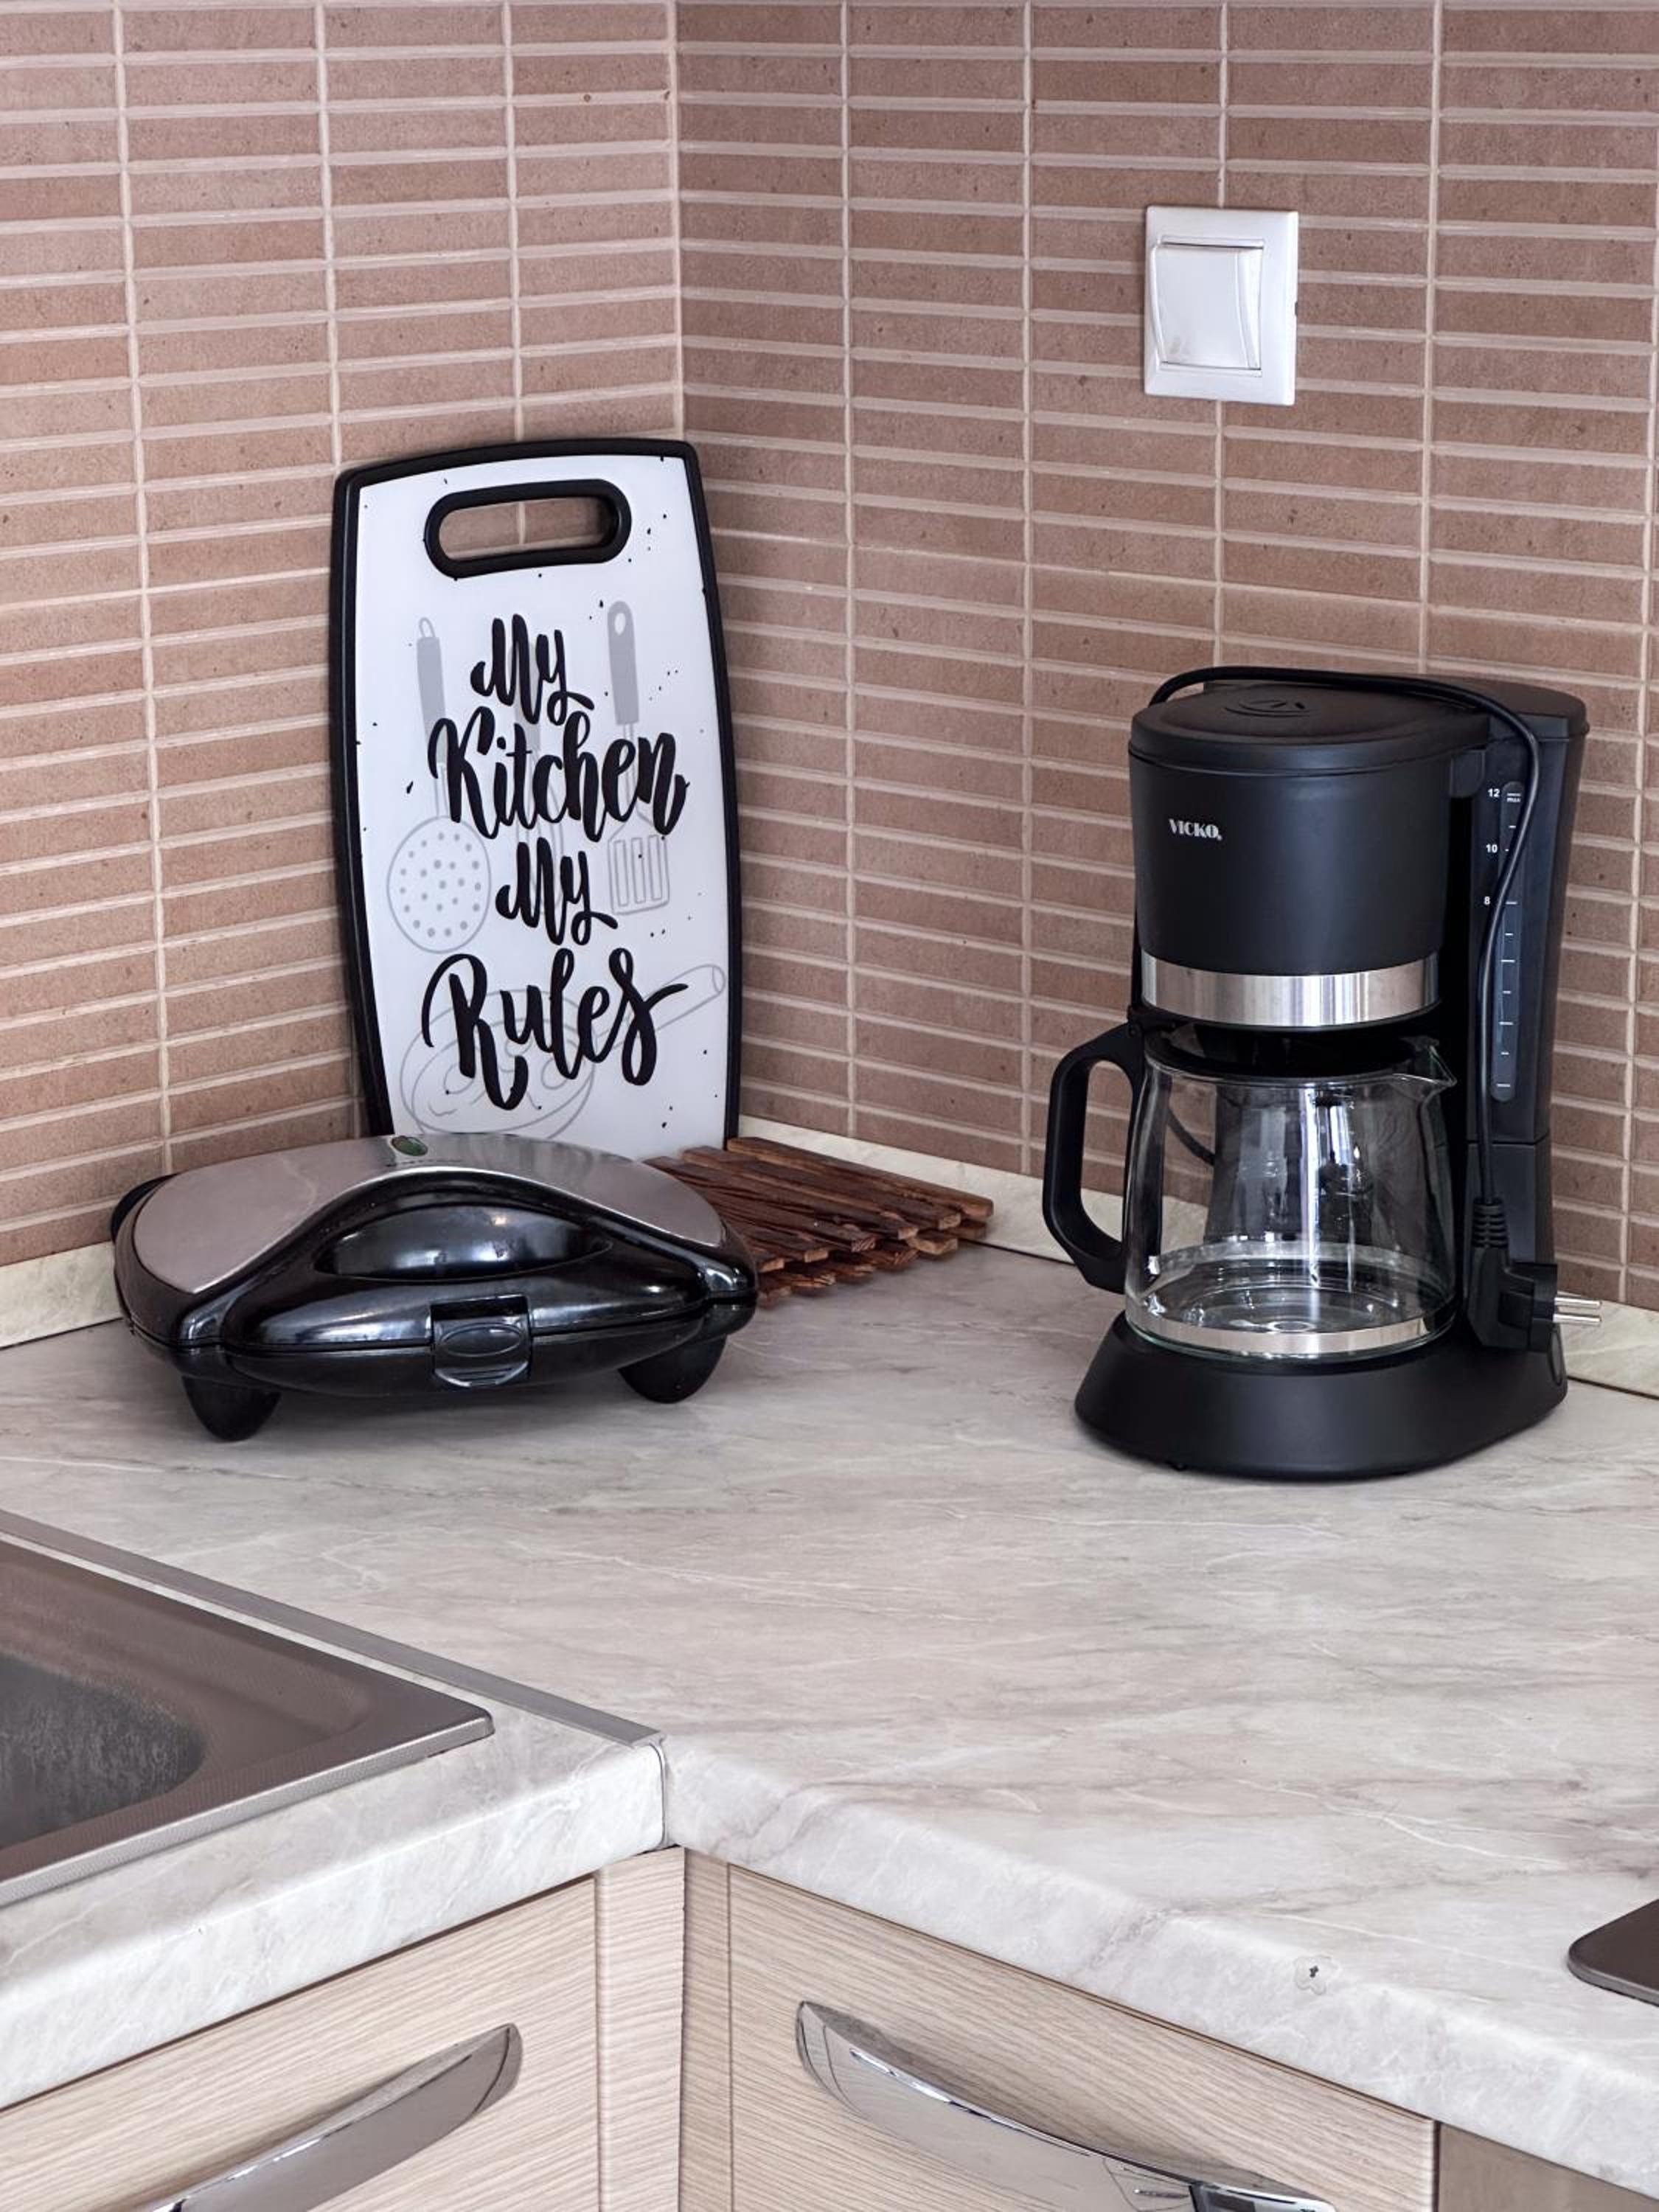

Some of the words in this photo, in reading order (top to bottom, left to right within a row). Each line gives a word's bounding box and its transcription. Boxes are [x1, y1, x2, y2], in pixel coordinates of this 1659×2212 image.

[470, 614, 594, 726] My
[428, 706, 690, 843] Kitchen
[1487, 787, 1500, 798] 12
[495, 838, 618, 946] My
[1484, 896, 1491, 906] 8
[1486, 844, 1498, 854] 10
[421, 947, 689, 1111] Rules
